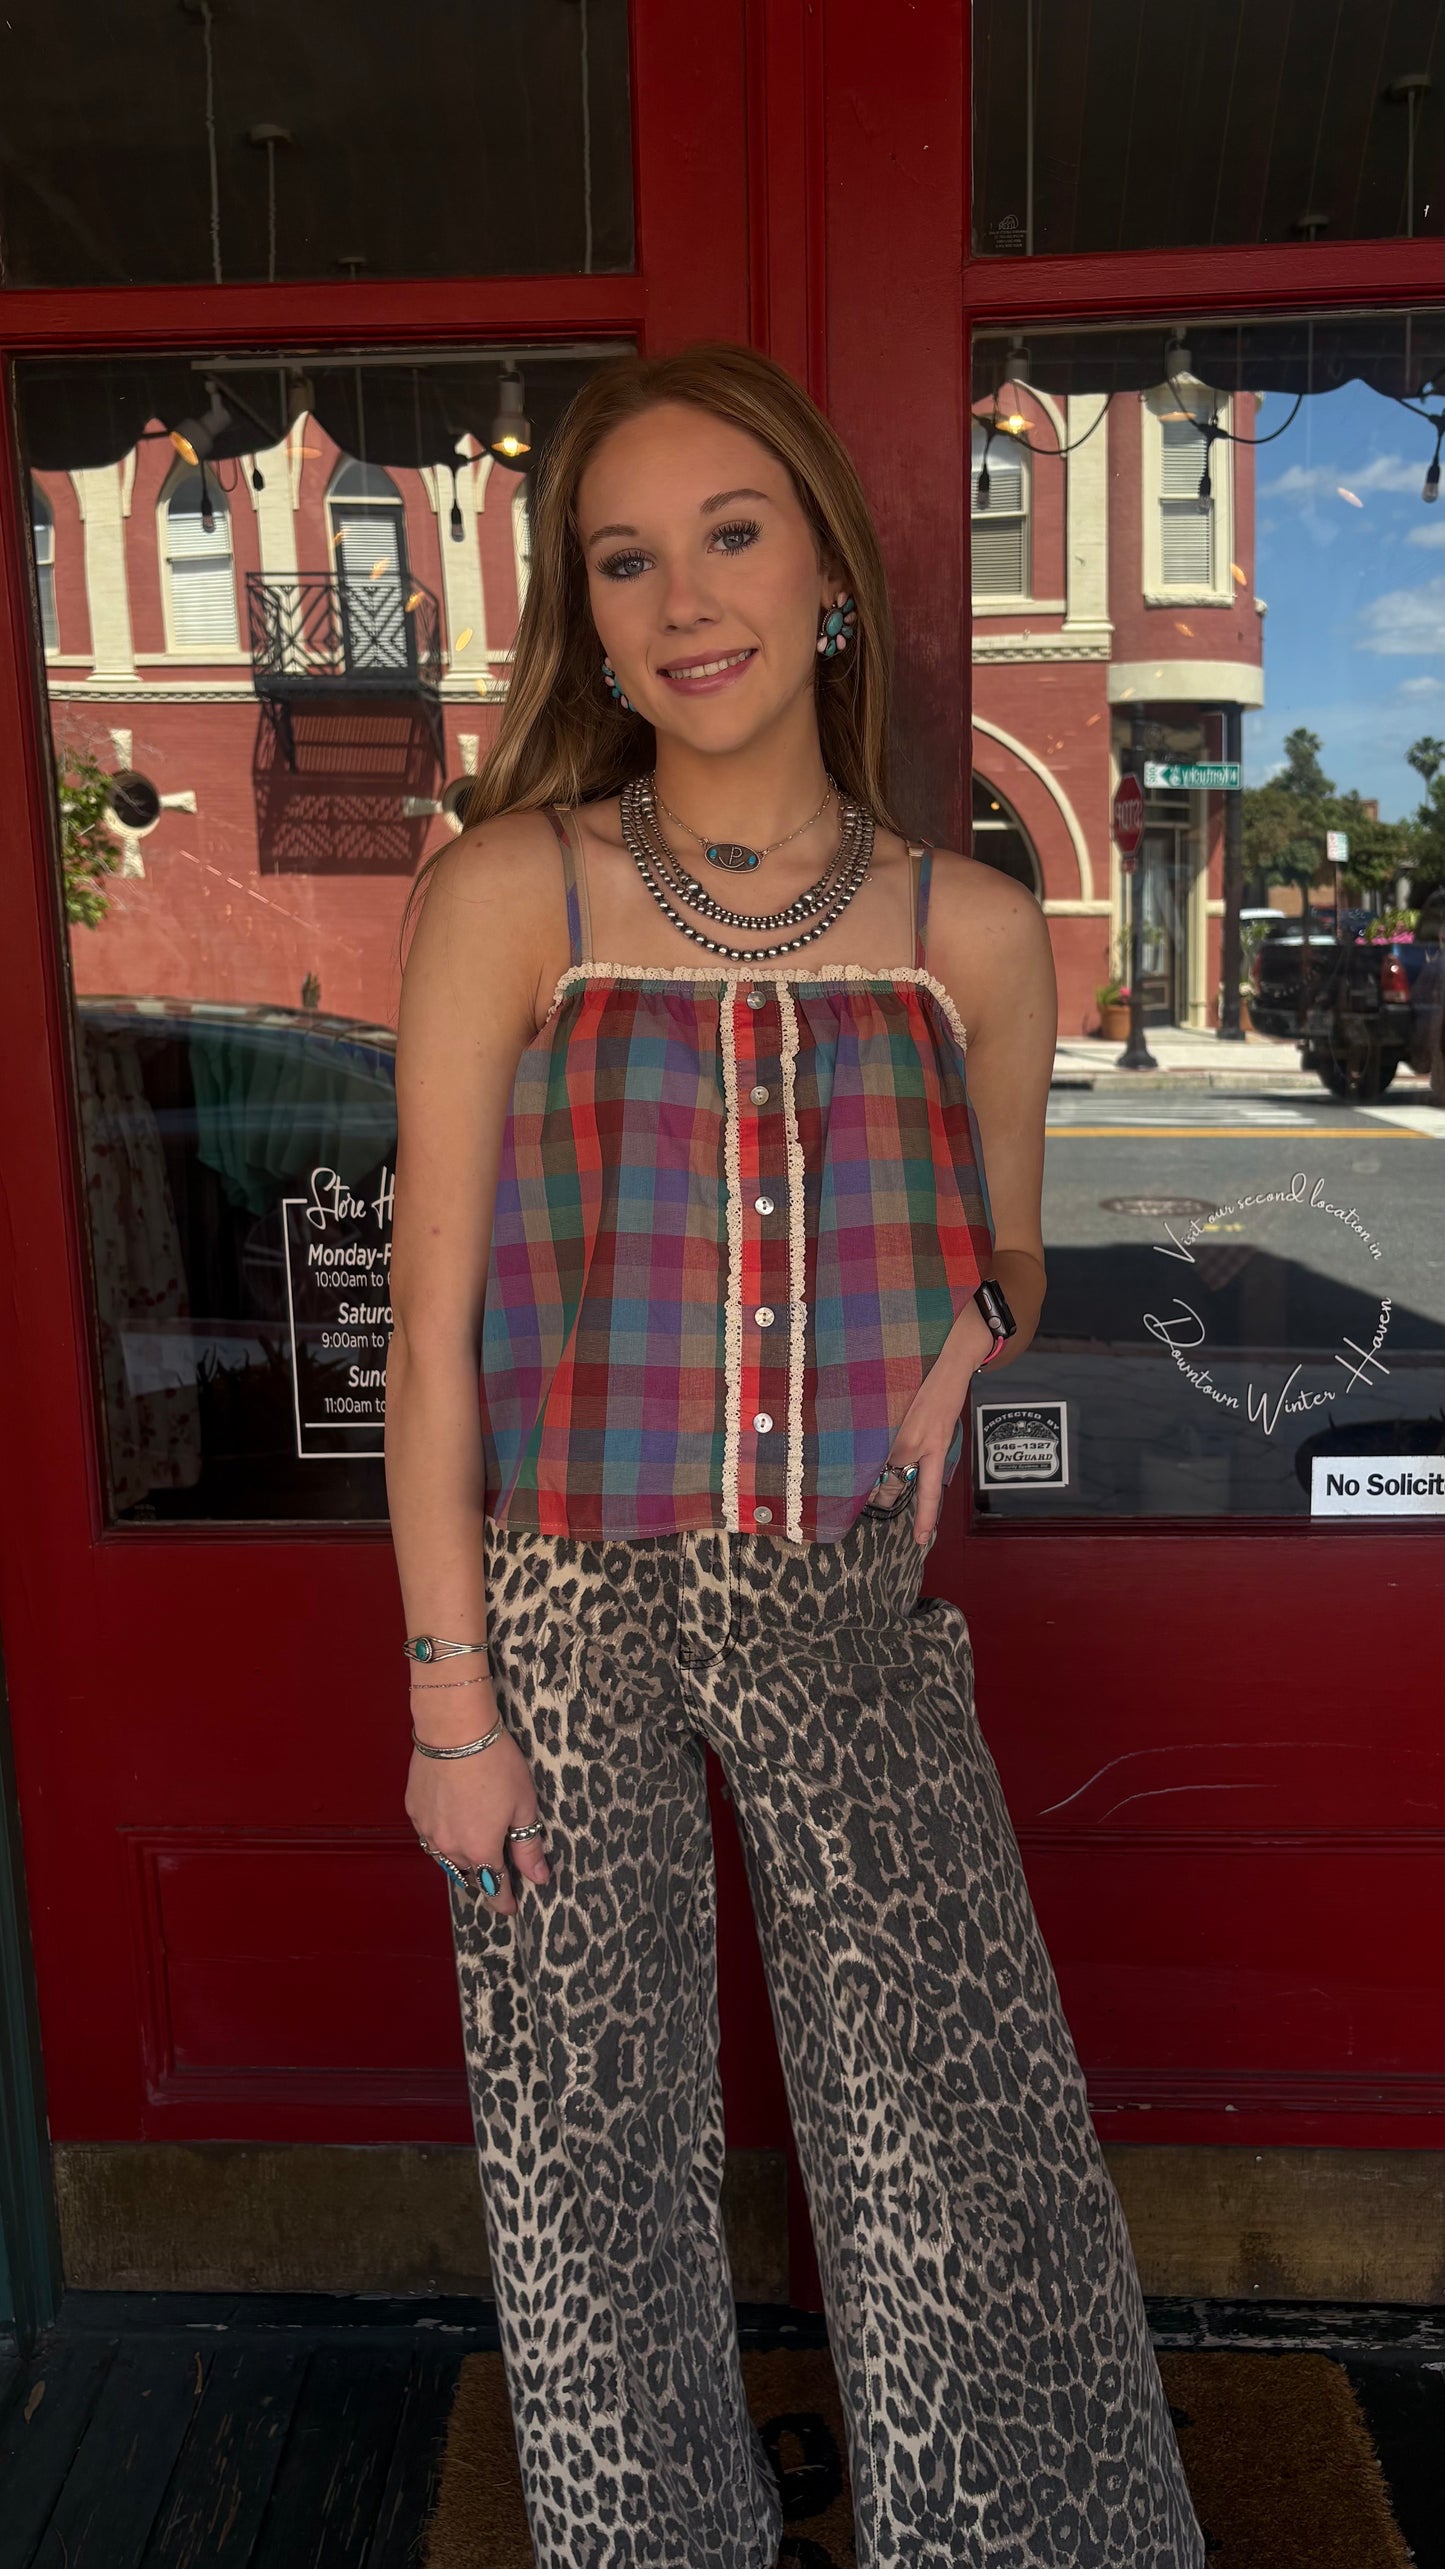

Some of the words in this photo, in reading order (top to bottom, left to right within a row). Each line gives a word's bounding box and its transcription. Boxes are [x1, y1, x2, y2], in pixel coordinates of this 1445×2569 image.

[306, 1167, 367, 1230] Store
[1153, 1218, 1205, 1263] Visit
[1208, 1205, 1234, 1224] our
[1237, 1172, 1306, 1209] second
[1310, 1178, 1370, 1242] location
[1369, 1242, 1382, 1260] in
[315, 1271, 368, 1287] 10:00am
[371, 1271, 384, 1287] to
[322, 1332, 369, 1348] 9:00am
[372, 1332, 385, 1348] to
[1143, 1298, 1240, 1409] Downtown
[1247, 1363, 1336, 1436] Winter
[1334, 1297, 1392, 1394] Haven
[324, 1397, 372, 1413] 11:00am
[983, 1411, 1042, 1432] PROTECTED
[1046, 1419, 1060, 1431] BY
[993, 1442, 1051, 1451] 646-1327
[1326, 1473, 1360, 1496] No
[1366, 1472, 1445, 1496] Solicit
